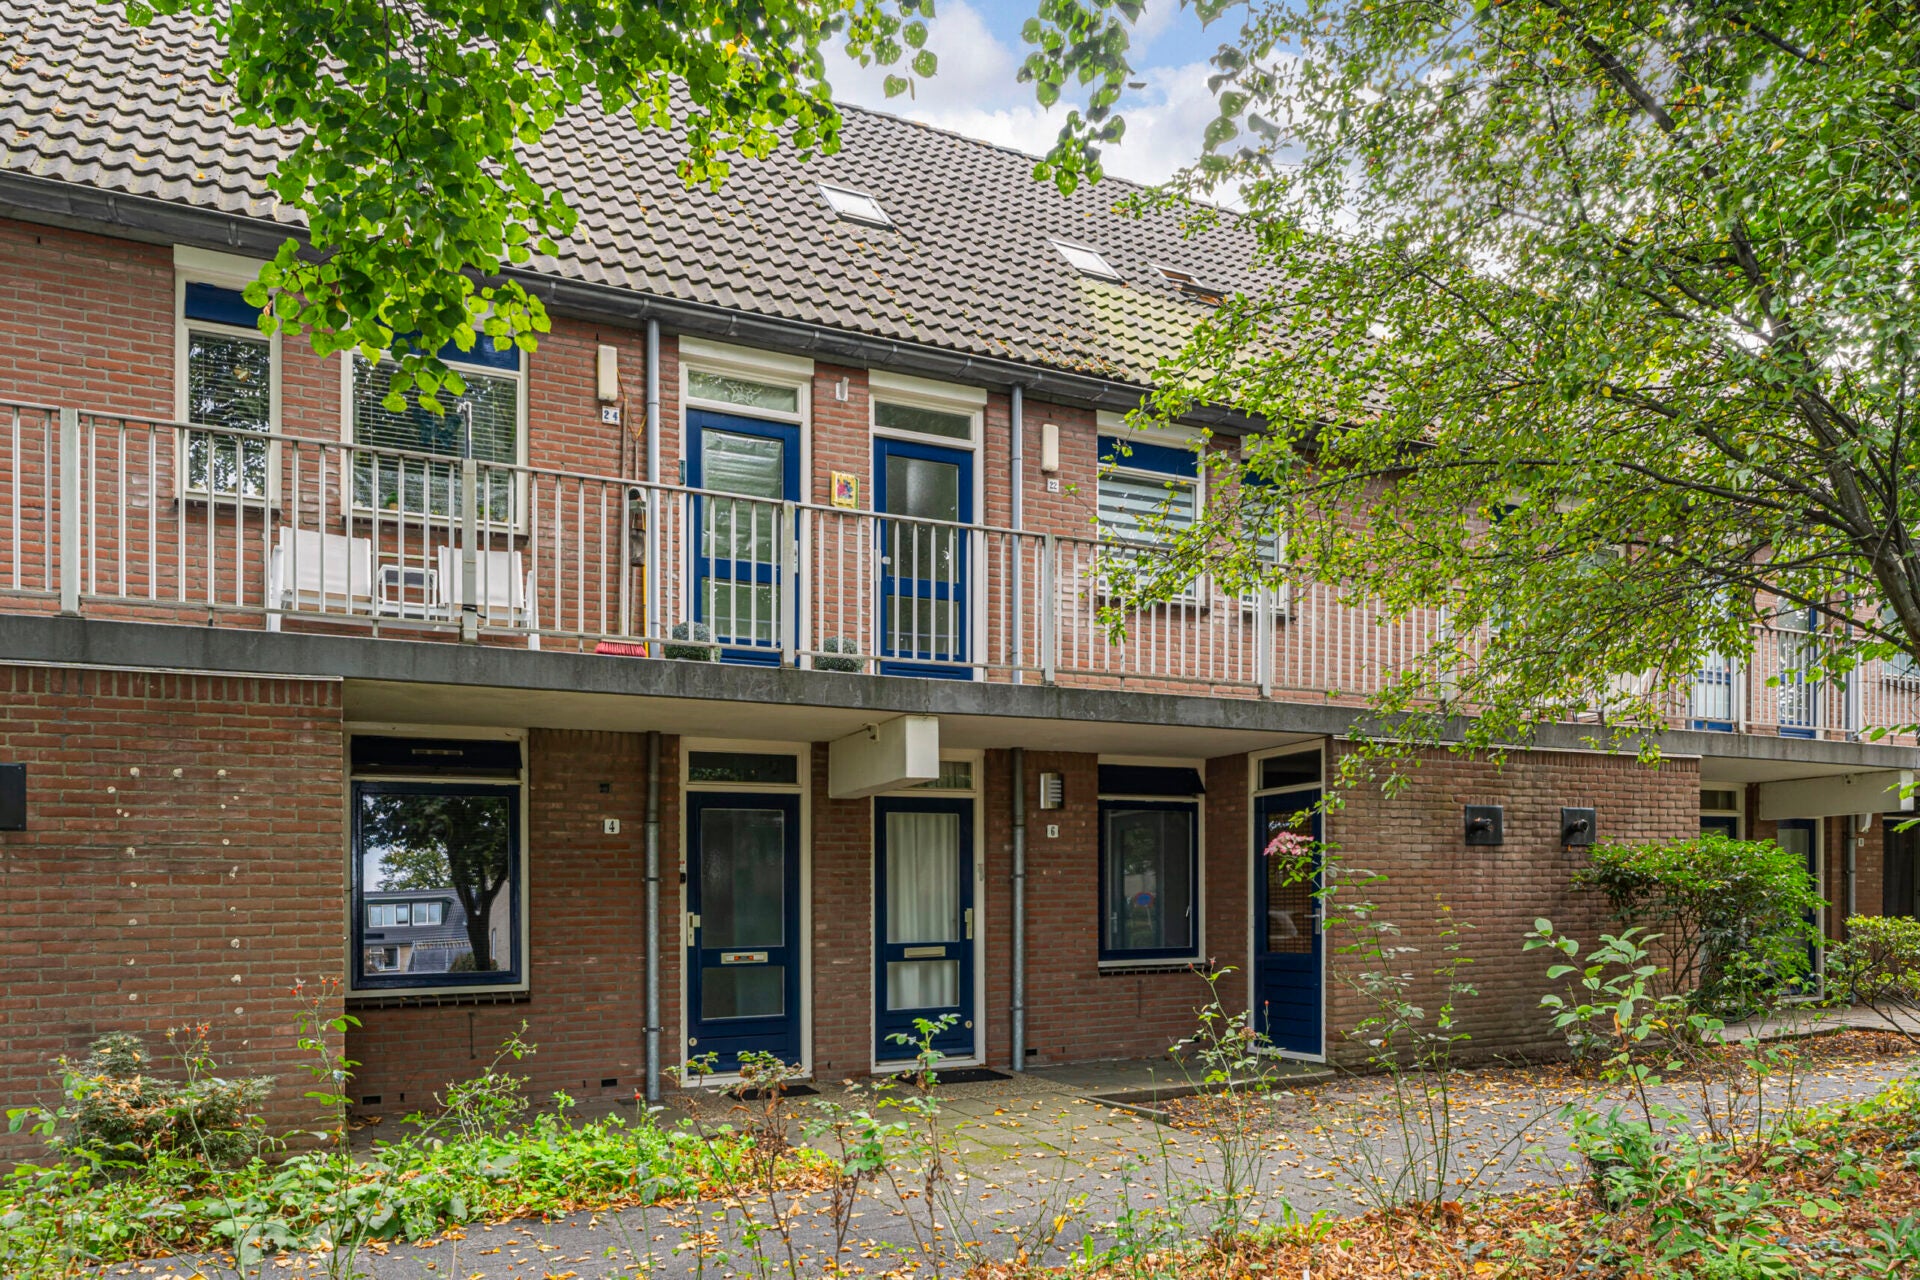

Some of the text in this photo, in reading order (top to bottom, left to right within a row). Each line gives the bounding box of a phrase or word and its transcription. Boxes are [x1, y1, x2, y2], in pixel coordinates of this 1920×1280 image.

[604, 409, 618, 421] 24
[1049, 481, 1057, 490] 22
[608, 820, 615, 832] 4
[1050, 826, 1056, 836] 6
